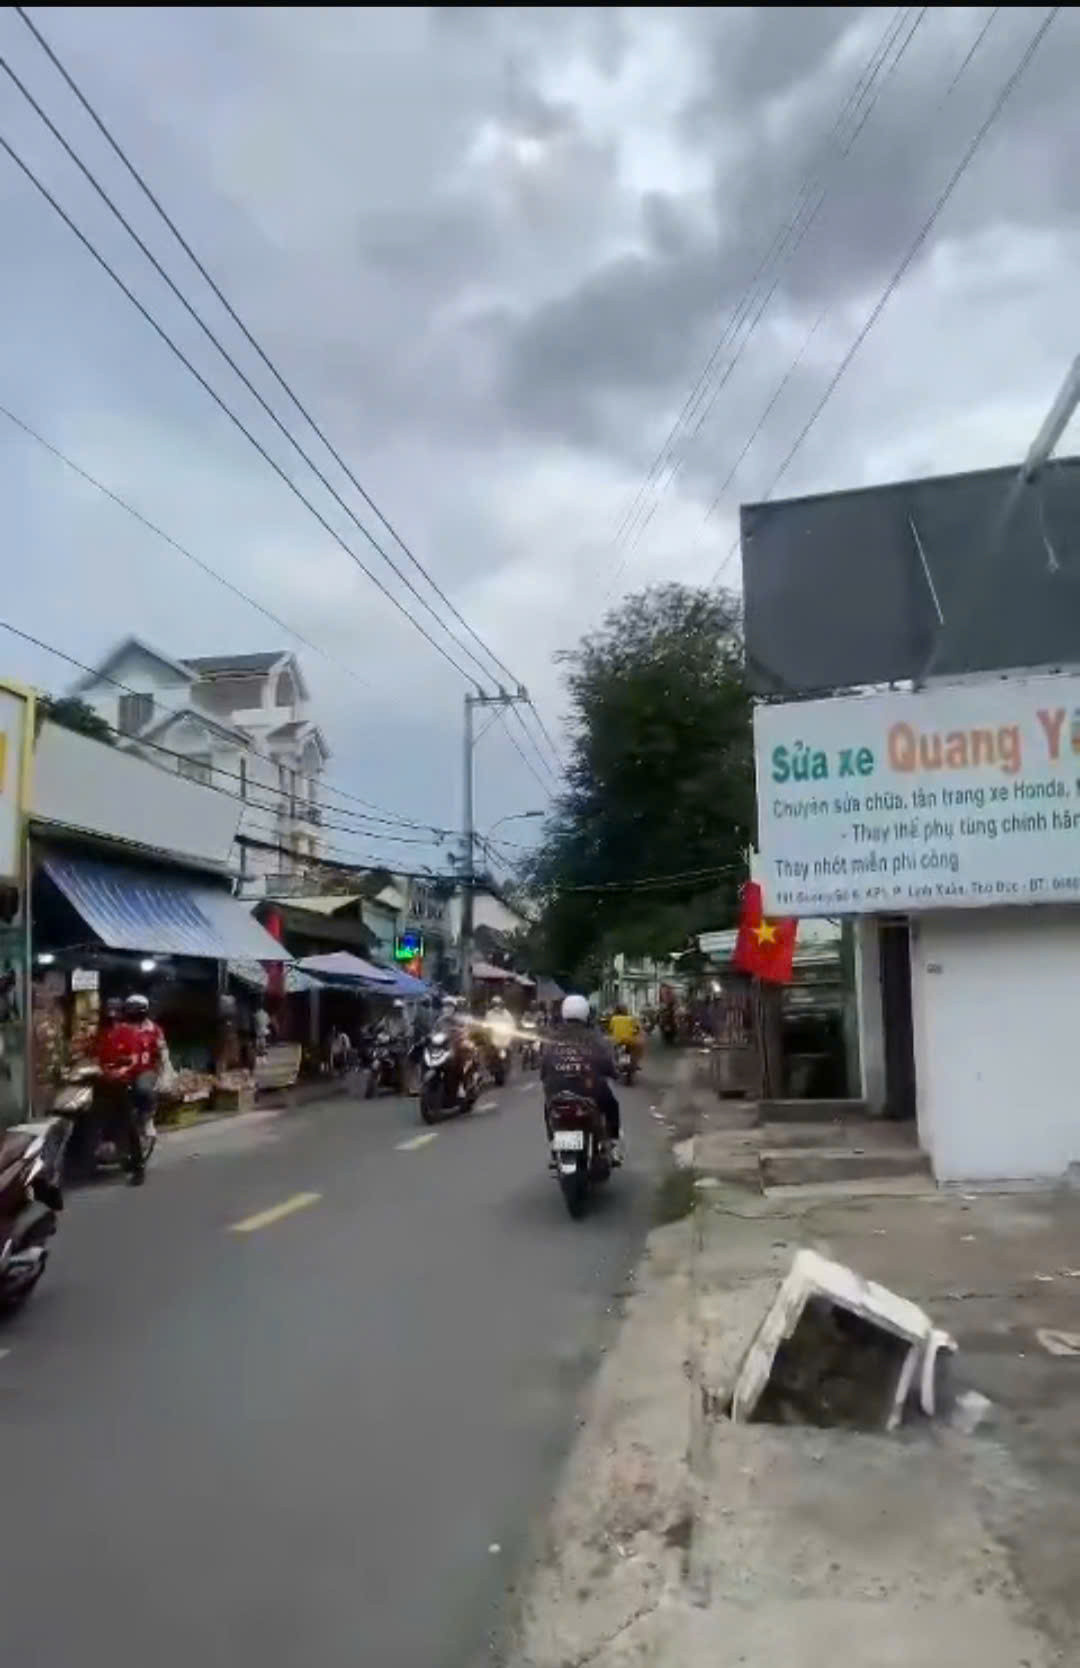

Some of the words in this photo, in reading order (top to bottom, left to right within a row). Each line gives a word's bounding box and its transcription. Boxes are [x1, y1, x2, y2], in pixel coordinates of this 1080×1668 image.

[772, 739, 829, 783] Sửa
[838, 746, 874, 777] xe
[888, 721, 1022, 775] Quang
[942, 787, 984, 808] trang
[989, 786, 1009, 801] xe
[1014, 778, 1071, 799] Honda,
[852, 823, 889, 844] Thay
[893, 816, 918, 839] thế
[924, 818, 954, 843] phụ
[960, 818, 998, 838] tùng
[775, 859, 808, 881] Thay
[851, 850, 887, 873] miễn
